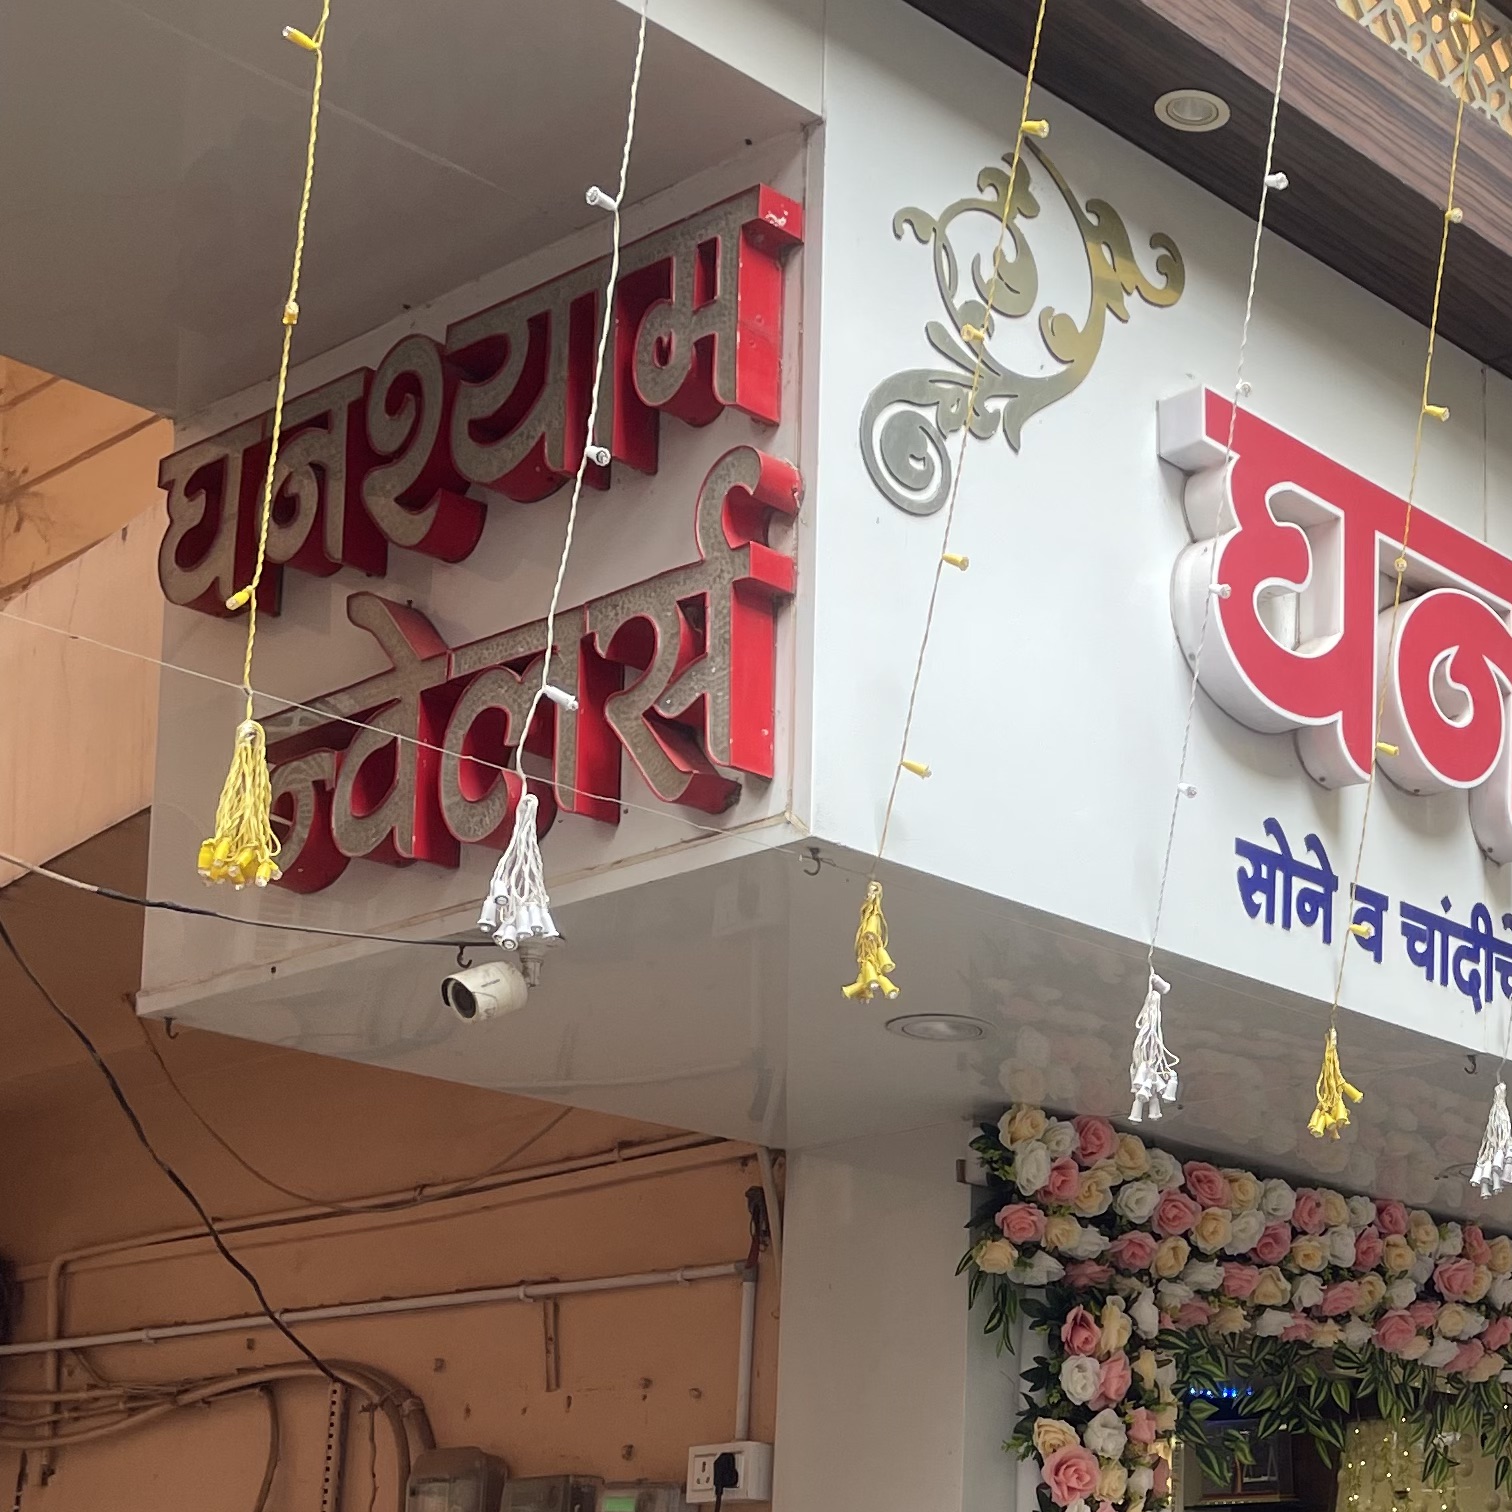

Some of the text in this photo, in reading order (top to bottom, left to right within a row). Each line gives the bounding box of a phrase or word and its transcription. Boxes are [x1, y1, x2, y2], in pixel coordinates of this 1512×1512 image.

[158, 184, 803, 618] घनश्याम
[1234, 816, 1339, 946] सोने
[1349, 881, 1390, 965] व
